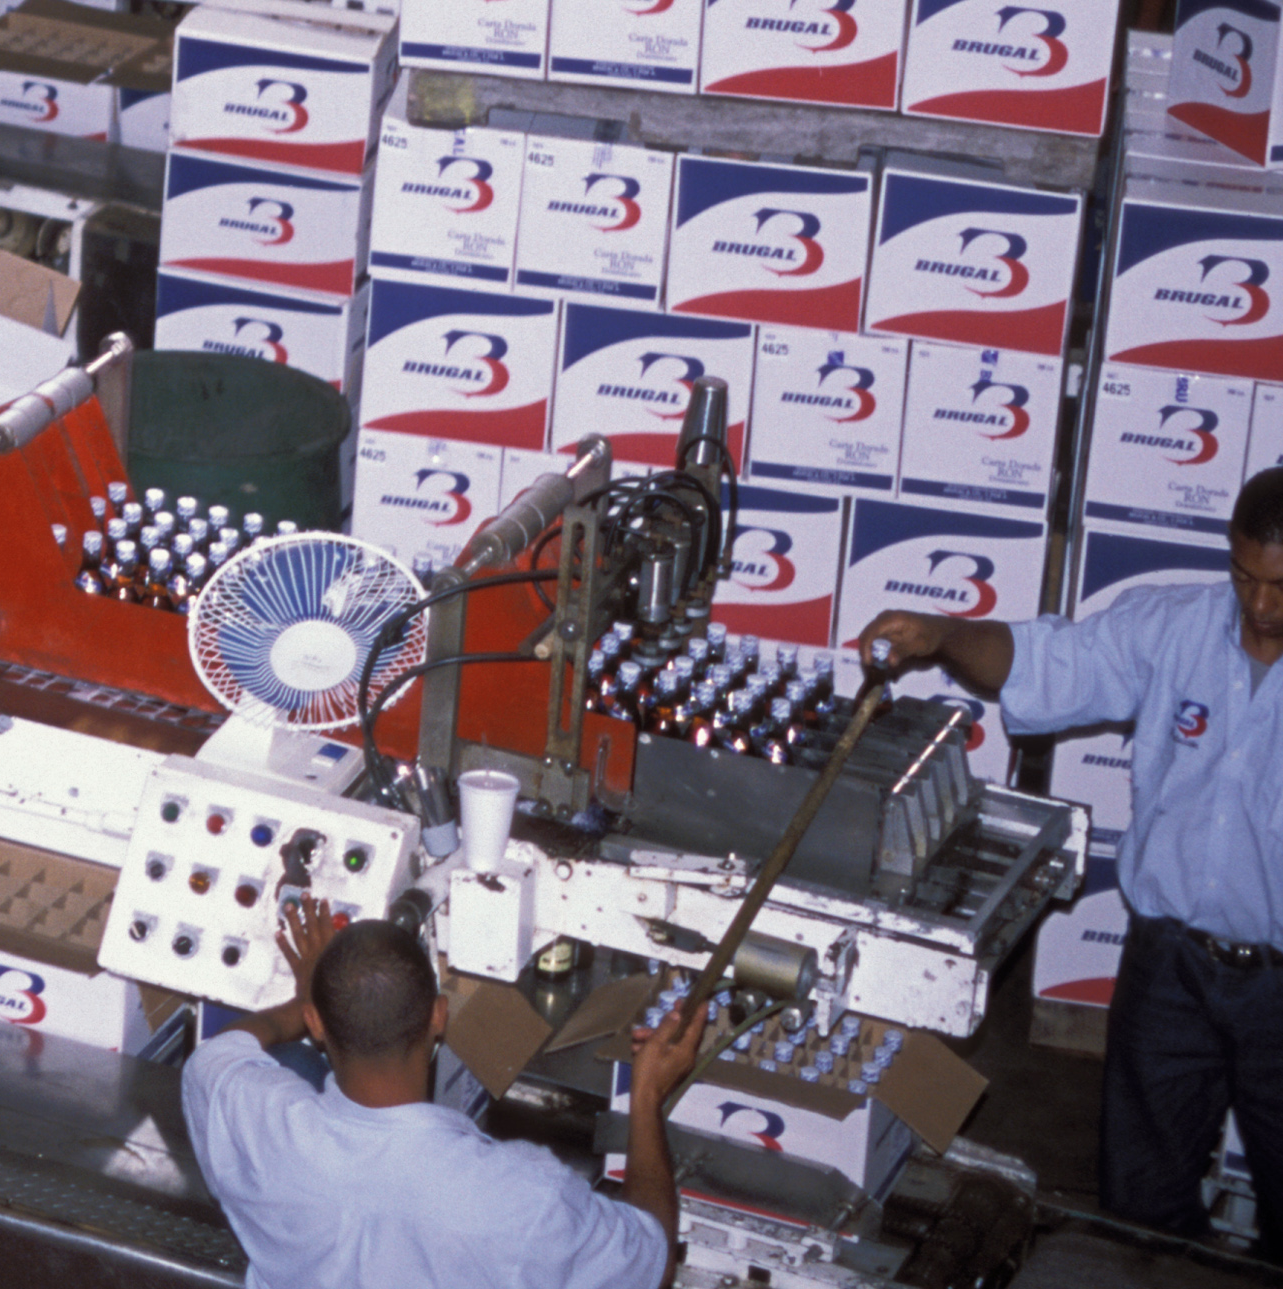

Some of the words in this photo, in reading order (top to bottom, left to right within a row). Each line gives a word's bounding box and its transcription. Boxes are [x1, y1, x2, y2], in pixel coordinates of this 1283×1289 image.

[745, 17, 832, 36] BRUGAL
[952, 39, 1041, 61] BRUGAL
[1192, 48, 1239, 82] BRUGAL
[225, 103, 288, 121] BRUGAL
[401, 182, 472, 200] BRUGAL
[547, 200, 619, 218] BRUGAL
[219, 217, 276, 234] BRUGAL
[712, 240, 798, 261] BRUGAL
[914, 259, 1003, 282] BRUGAL
[1154, 288, 1243, 310] BRUGAL
[761, 343, 789, 356] 4625
[402, 360, 485, 382] BRUGAL
[597, 384, 681, 405] BRUGAL
[1103, 381, 1131, 396] 4625
[781, 392, 854, 409] BRUGAL
[933, 408, 1007, 426] BRUGAL
[1120, 432, 1195, 451] BRUGAL
[381, 494, 451, 513] BRUGAL
[885, 580, 970, 602] BRUGAL
[1081, 754, 1131, 770] BRUG
